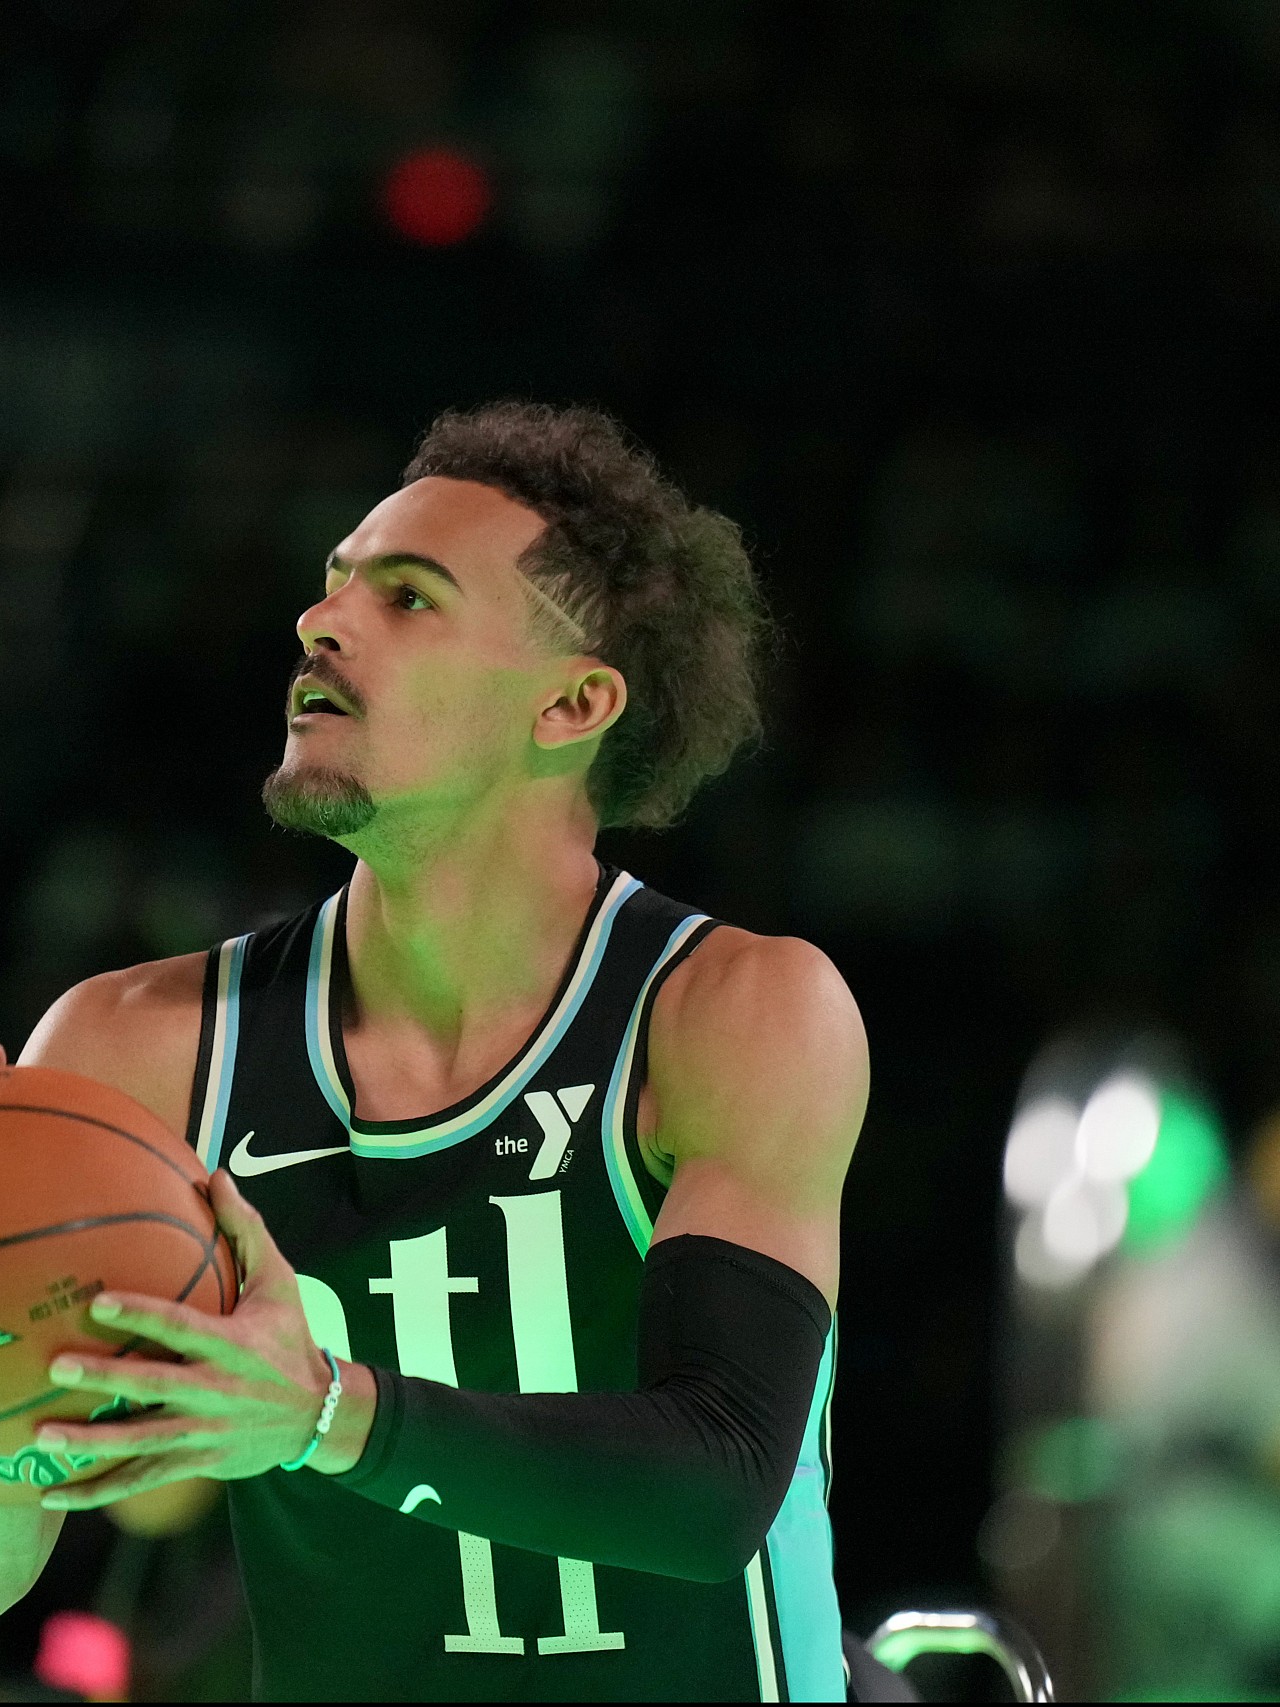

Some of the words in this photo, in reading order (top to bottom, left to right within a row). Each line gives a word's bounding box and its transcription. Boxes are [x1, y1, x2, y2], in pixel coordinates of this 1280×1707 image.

[494, 1135, 529, 1156] the
[523, 1083, 596, 1181] Y
[558, 1149, 575, 1174] YMCA
